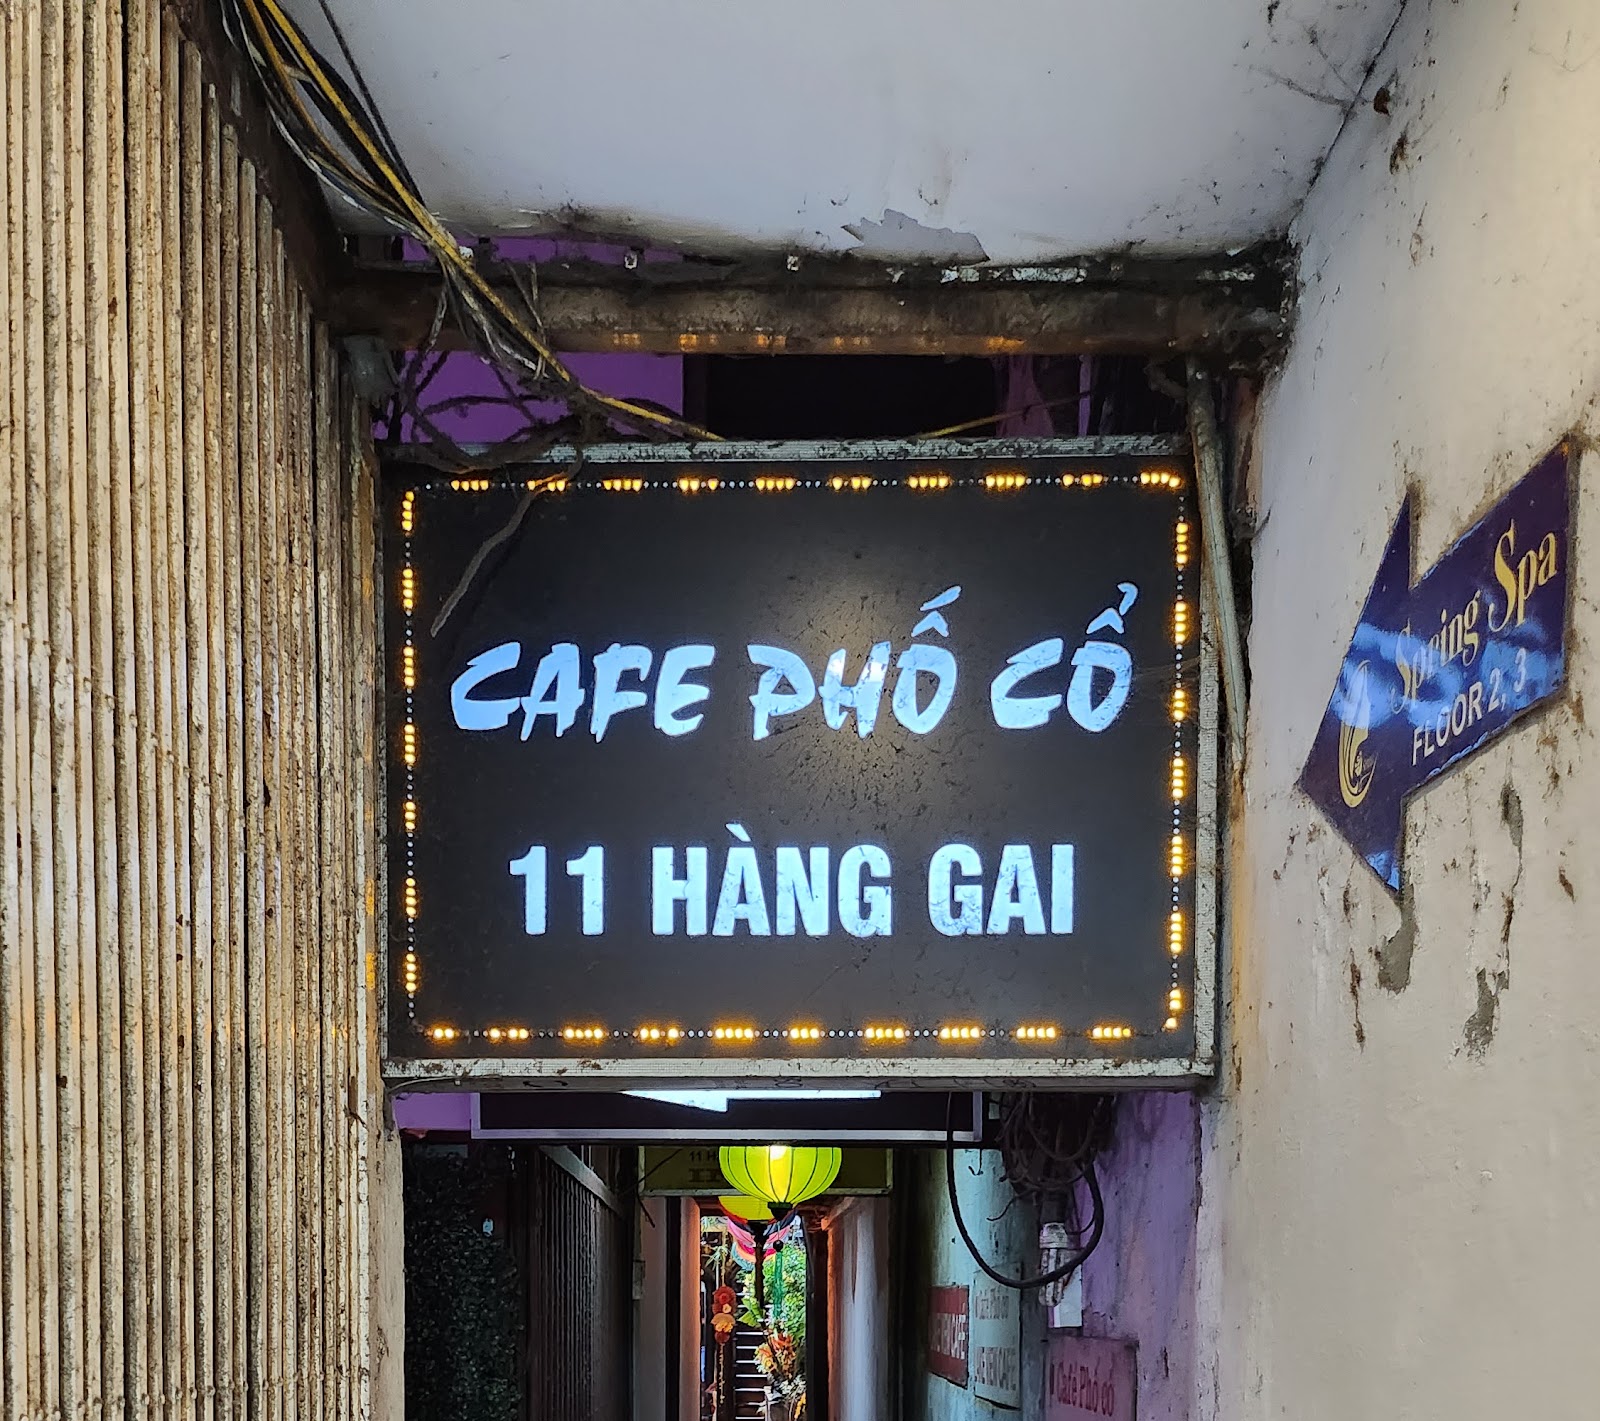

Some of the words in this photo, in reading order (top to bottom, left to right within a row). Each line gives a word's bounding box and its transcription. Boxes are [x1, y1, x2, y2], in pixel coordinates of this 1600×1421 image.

[450, 642, 716, 743] CAFE
[746, 585, 963, 741] PHỐ
[990, 582, 1139, 733] CỔ
[1391, 588, 1481, 715] Spring
[1488, 518, 1557, 632] Spa
[1412, 680, 1483, 766] FLOOR
[1513, 648, 1528, 694] 3
[509, 844, 605, 937] 11
[652, 822, 893, 938] HÀNG
[927, 842, 1075, 938] GAI
